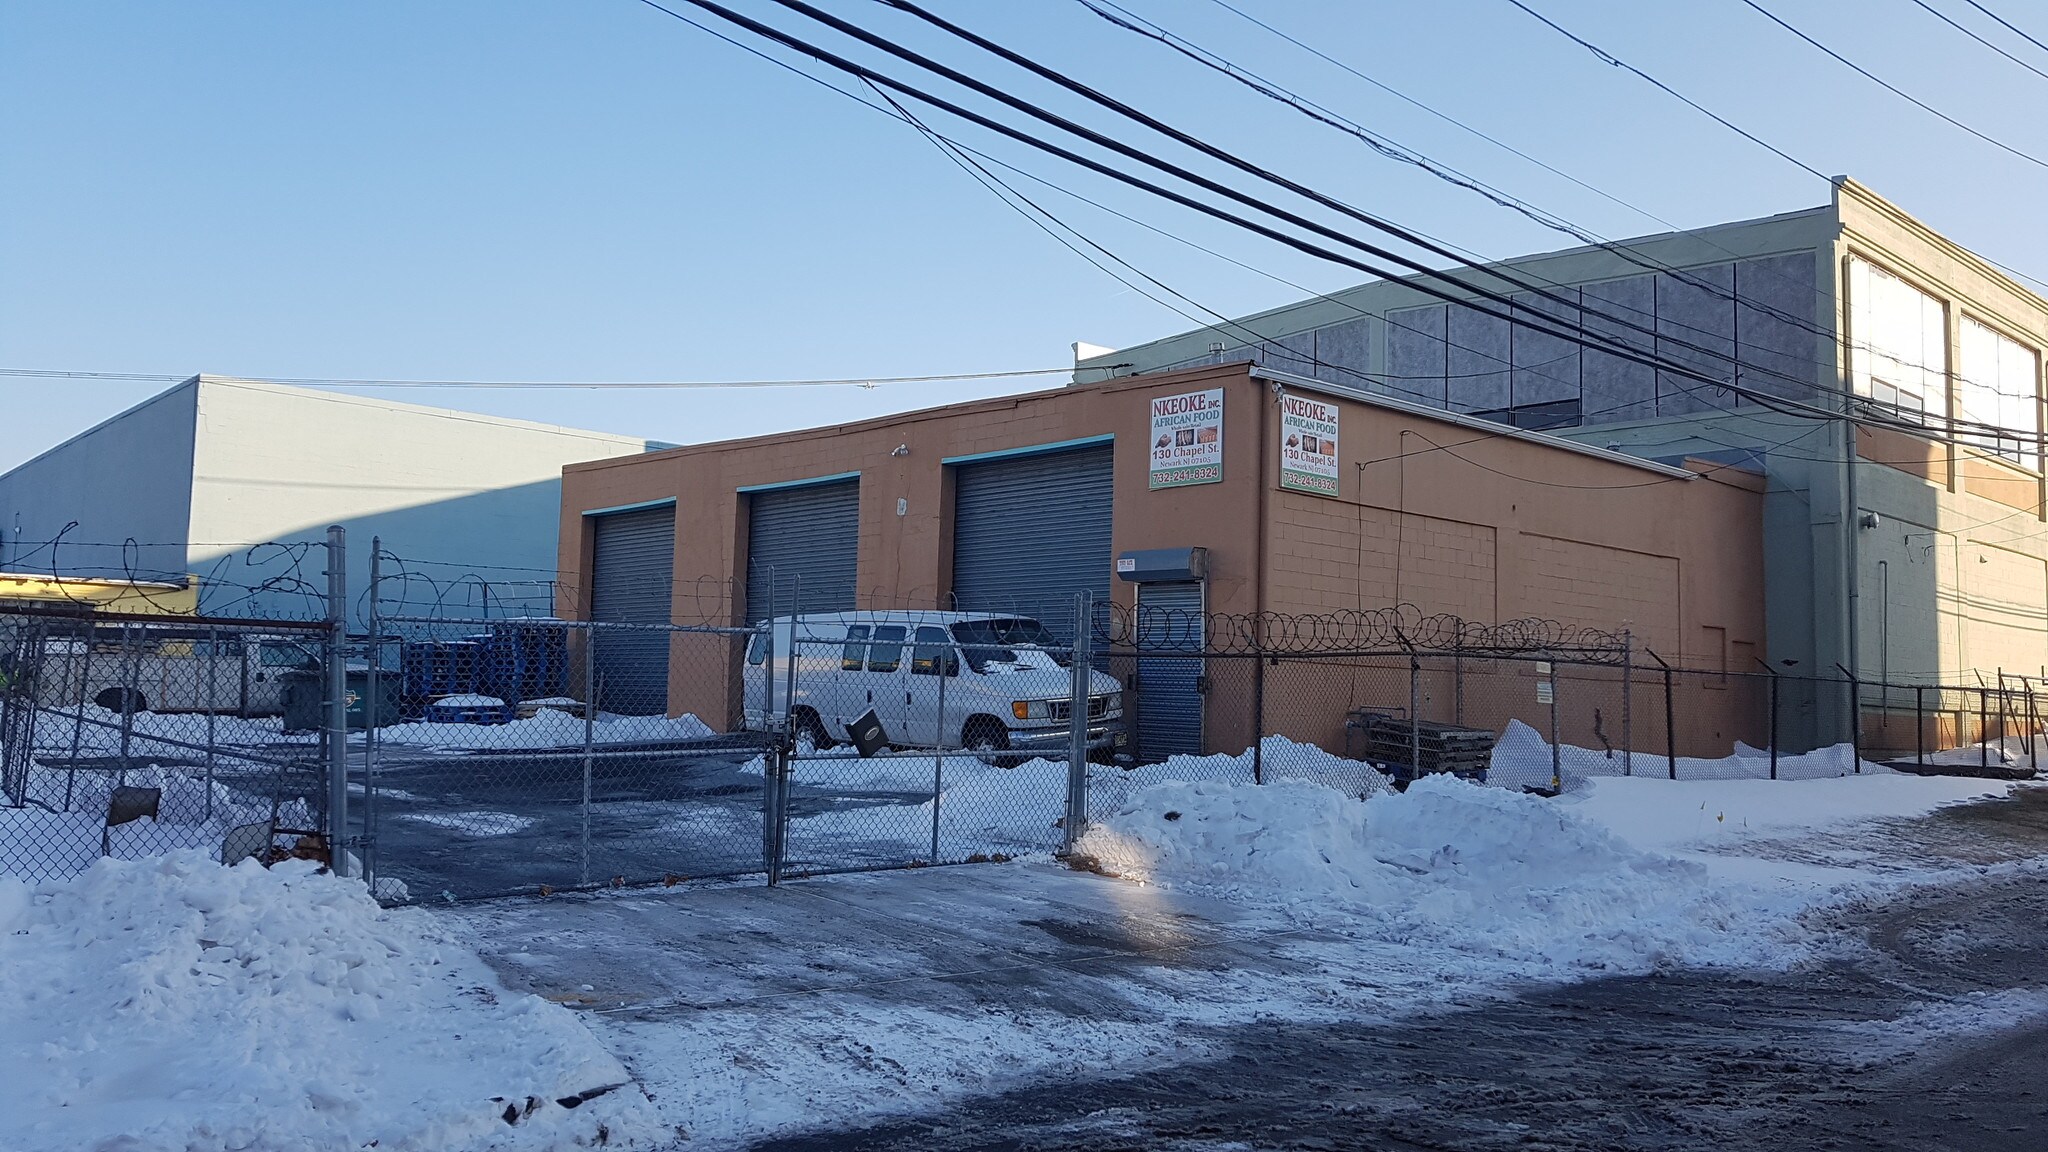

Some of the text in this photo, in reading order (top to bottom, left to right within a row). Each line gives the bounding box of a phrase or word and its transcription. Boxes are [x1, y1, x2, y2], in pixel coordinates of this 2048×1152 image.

[1154, 394, 1206, 417] NKEOKE
[1284, 397, 1325, 422] NKEOKE
[1154, 410, 1220, 428] AFRICAN FOOD
[1285, 416, 1336, 435] AFRICAN FOOD
[1153, 444, 1219, 460] 130 Chapel St.
[1284, 448, 1336, 467] 130 Chapel St.
[1160, 459, 1182, 467] Newark
[1290, 461, 1307, 470] Newark
[1153, 467, 1218, 483] 732-241-8324
[1284, 473, 1336, 491] 732-241-8324
